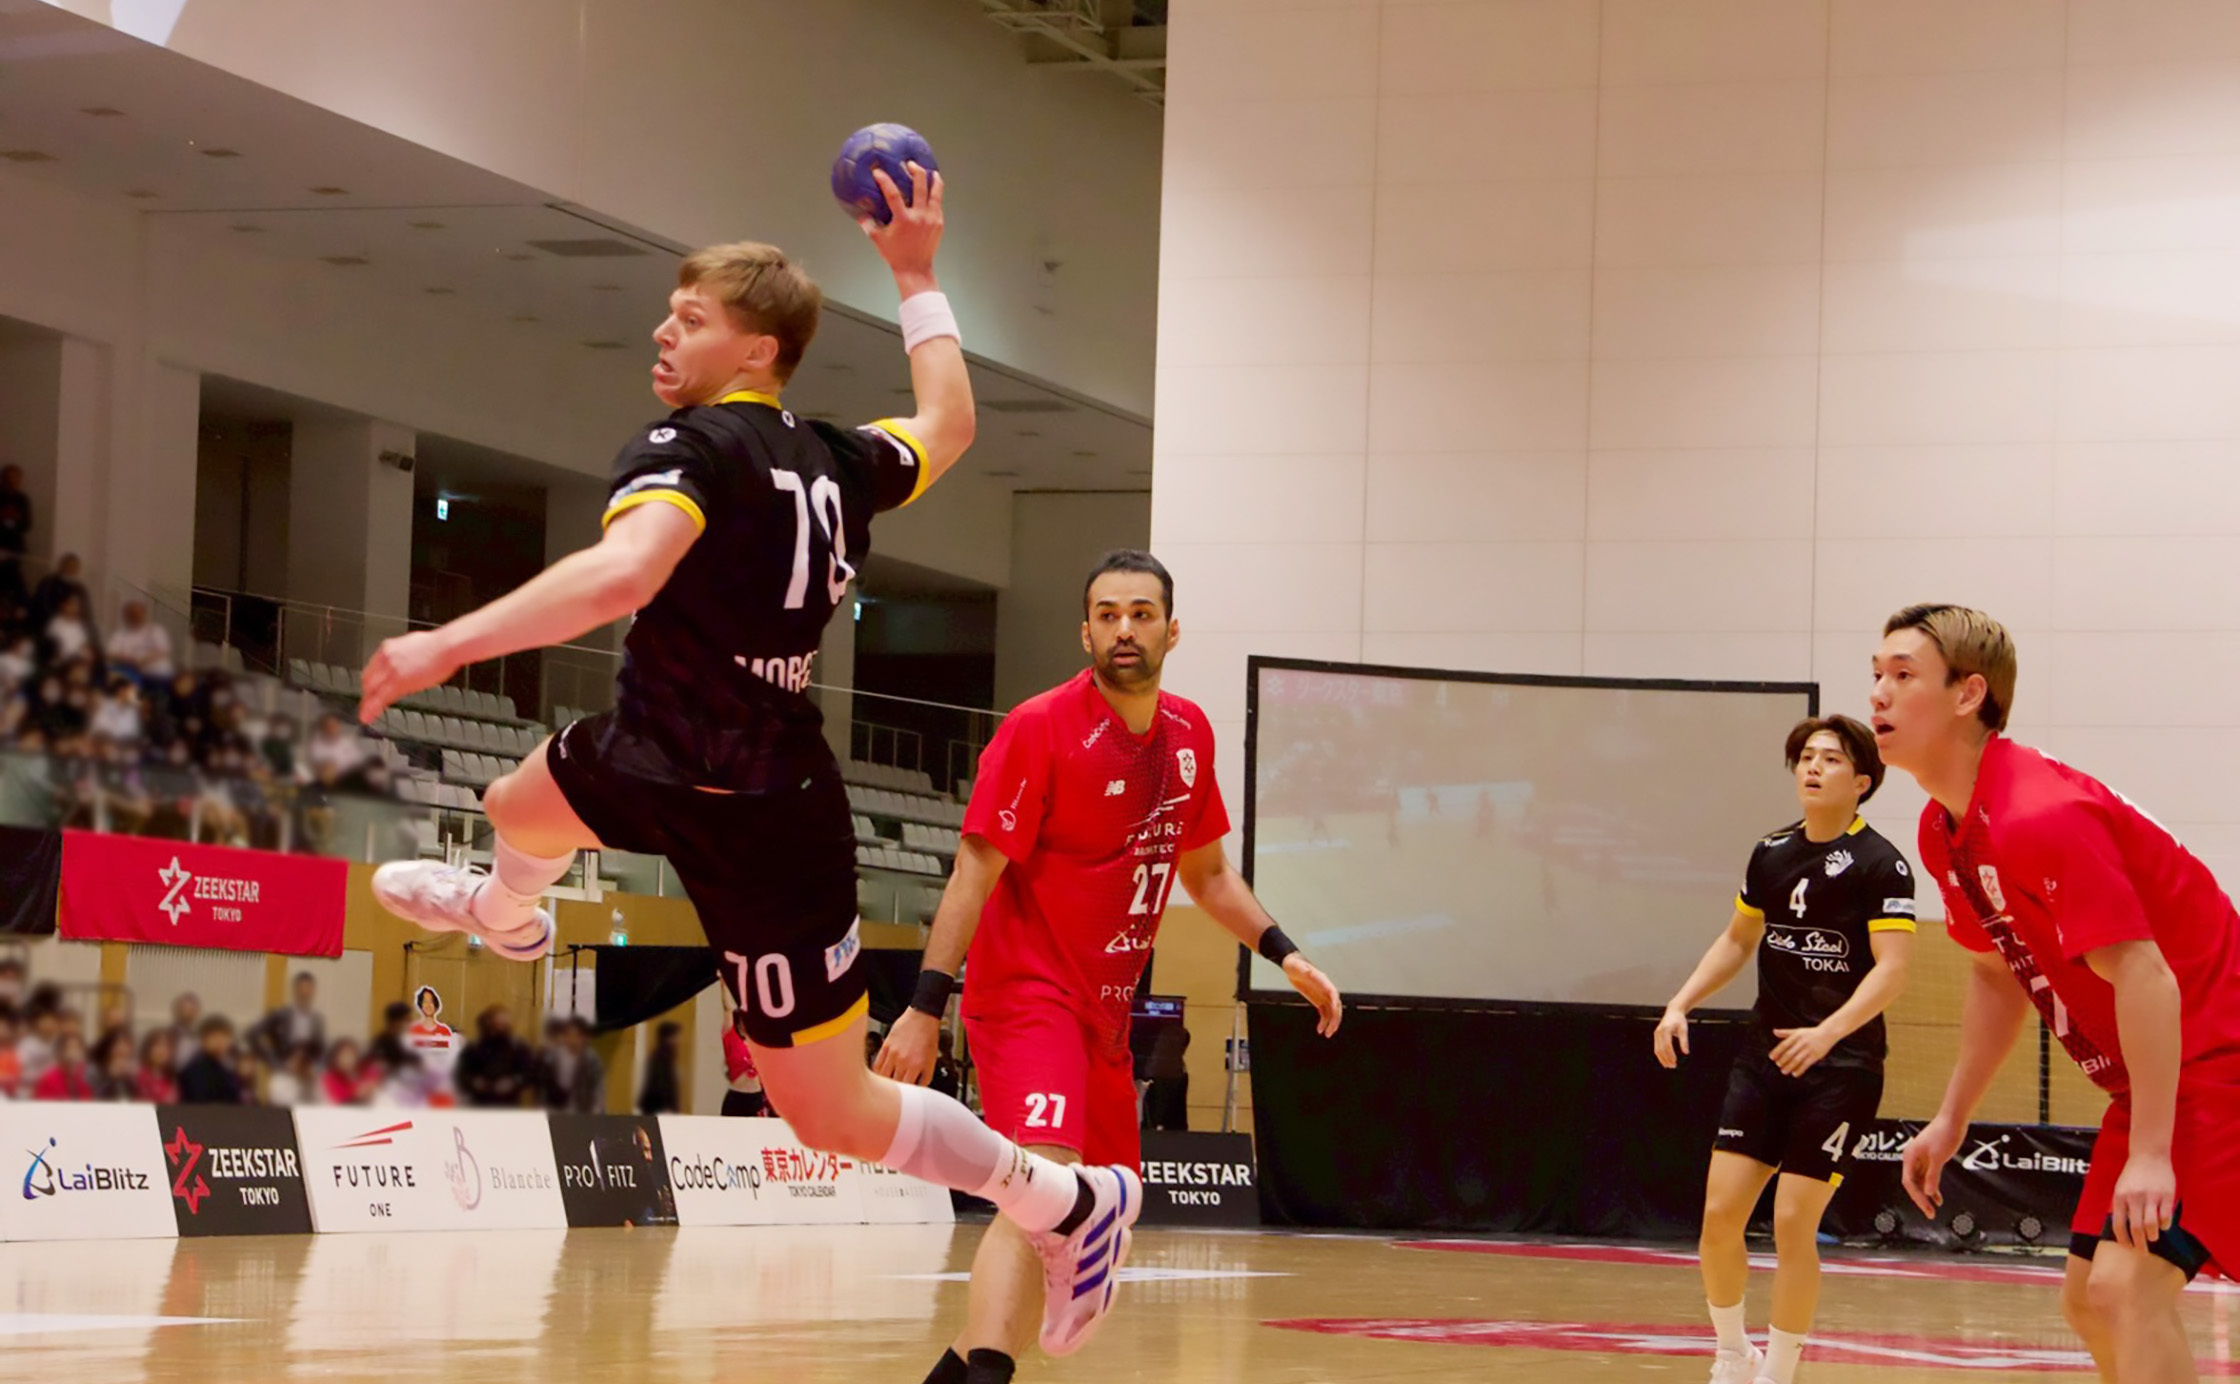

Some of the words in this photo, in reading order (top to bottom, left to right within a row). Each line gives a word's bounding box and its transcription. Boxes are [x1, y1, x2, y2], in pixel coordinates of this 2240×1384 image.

[770, 468, 856, 610] 70
[194, 876, 260, 903] ZEEKSTAR
[1128, 863, 1171, 915] 27
[1789, 878, 1809, 919] 4
[212, 906, 242, 922] TOKYO
[724, 950, 795, 1018] 70
[1025, 1093, 1066, 1129] 27
[1821, 1121, 1850, 1163] 4
[58, 1163, 149, 1190] LaiBlitz
[208, 1148, 300, 1178] ZEEKSTAR
[333, 1164, 416, 1188] FUTURE
[607, 1165, 637, 1188] FITZ
[489, 1166, 552, 1190] Blanche
[239, 1187, 280, 1206] TOKYO
[369, 1202, 392, 1217] ONE
[1168, 1190, 1221, 1206] TOKYO
